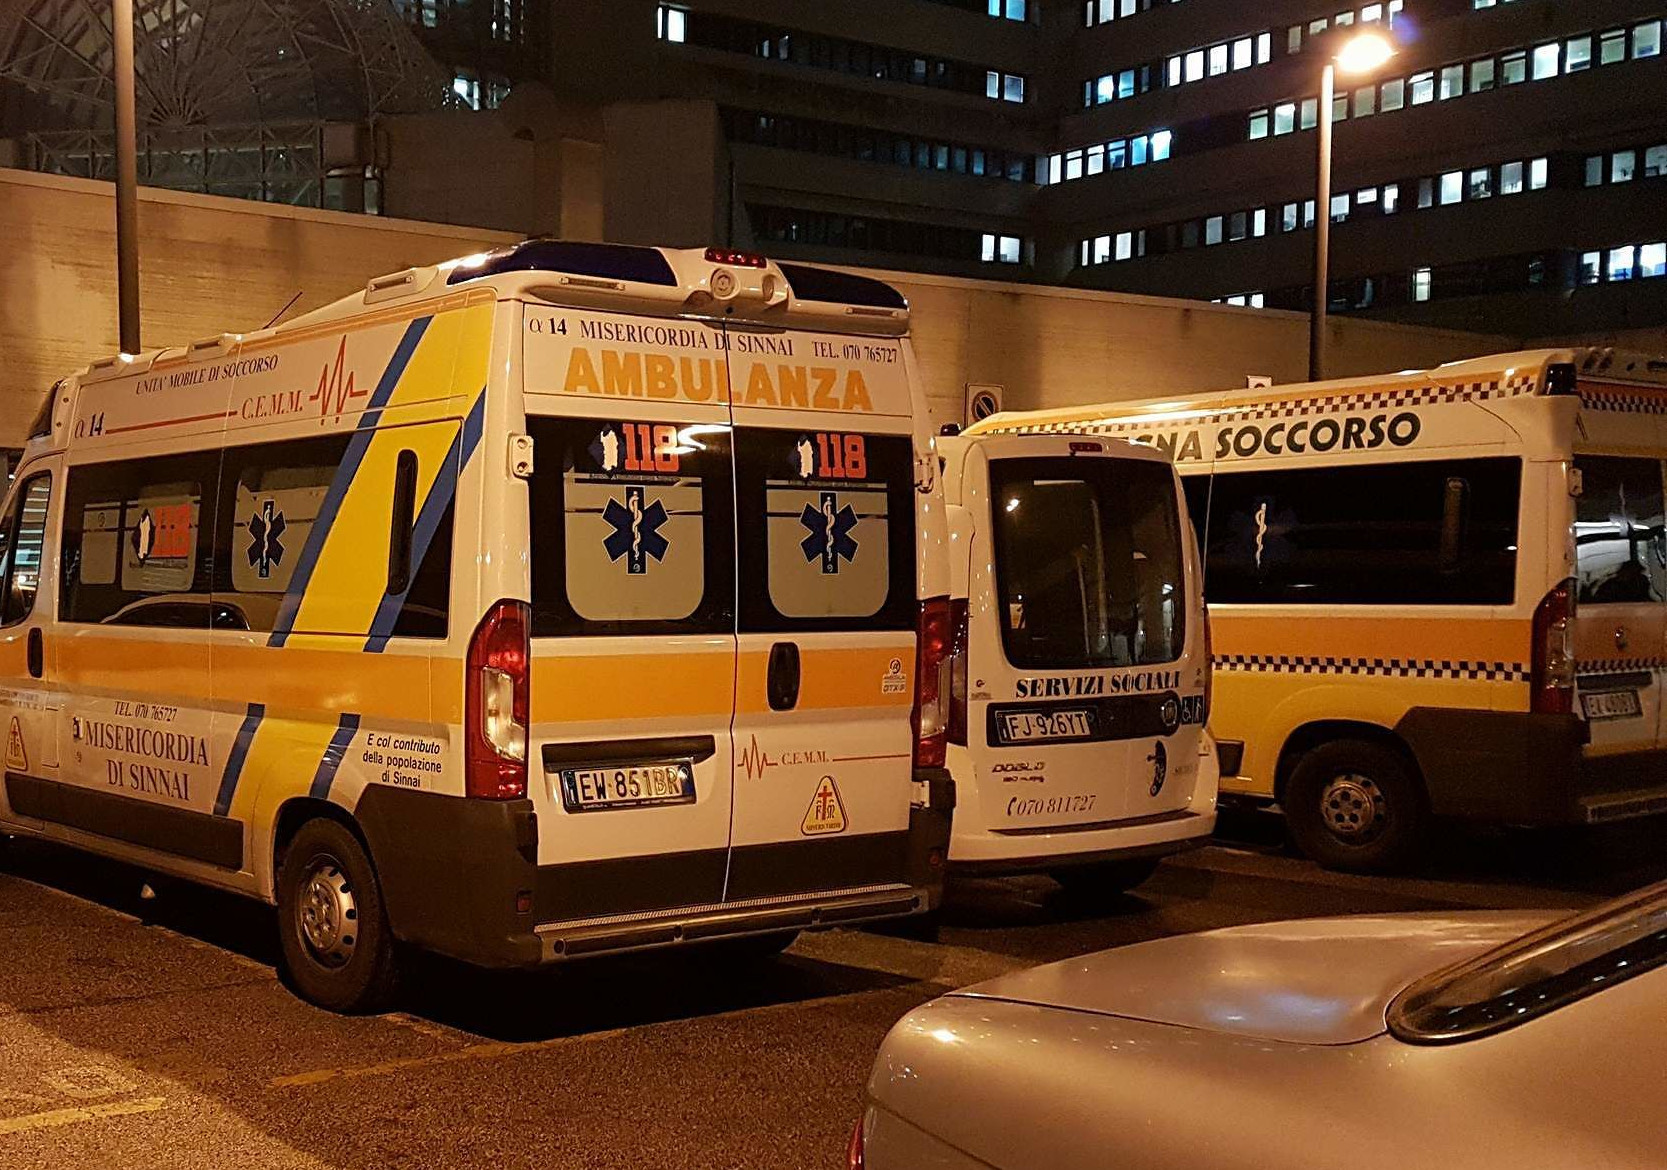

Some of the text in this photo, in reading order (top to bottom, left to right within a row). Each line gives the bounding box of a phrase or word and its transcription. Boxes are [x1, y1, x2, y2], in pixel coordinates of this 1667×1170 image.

[548, 317, 567, 336] 14
[580, 320, 708, 350] MISERICORDIA
[714, 332, 732, 351] DI
[737, 334, 794, 357] SINNAI
[812, 341, 840, 359] TEL.
[843, 344, 861, 361] 070
[864, 345, 898, 364] 765727
[169, 368, 207, 389] MOBILE
[208, 363, 220, 382] DI
[221, 354, 279, 380] SOCCORSO
[564, 347, 874, 413] AMBULANZA
[241, 390, 304, 421] C.E.M.M.
[88, 411, 105, 437] 14
[1215, 411, 1422, 460] SOCCORSO
[622, 422, 680, 473] 118
[817, 432, 867, 479] 118
[1015, 670, 1181, 699] SERVIZI SOCIALI
[114, 701, 178, 722] TEL. 070 765727
[85, 721, 209, 767] MISERICORDIA
[367, 733, 441, 755] E col contributo
[362, 750, 442, 773] della popolazione
[106, 759, 190, 801] DI SINNAI
[381, 770, 421, 788] di Sinnai
[1017, 794, 1097, 816] 070 811727
